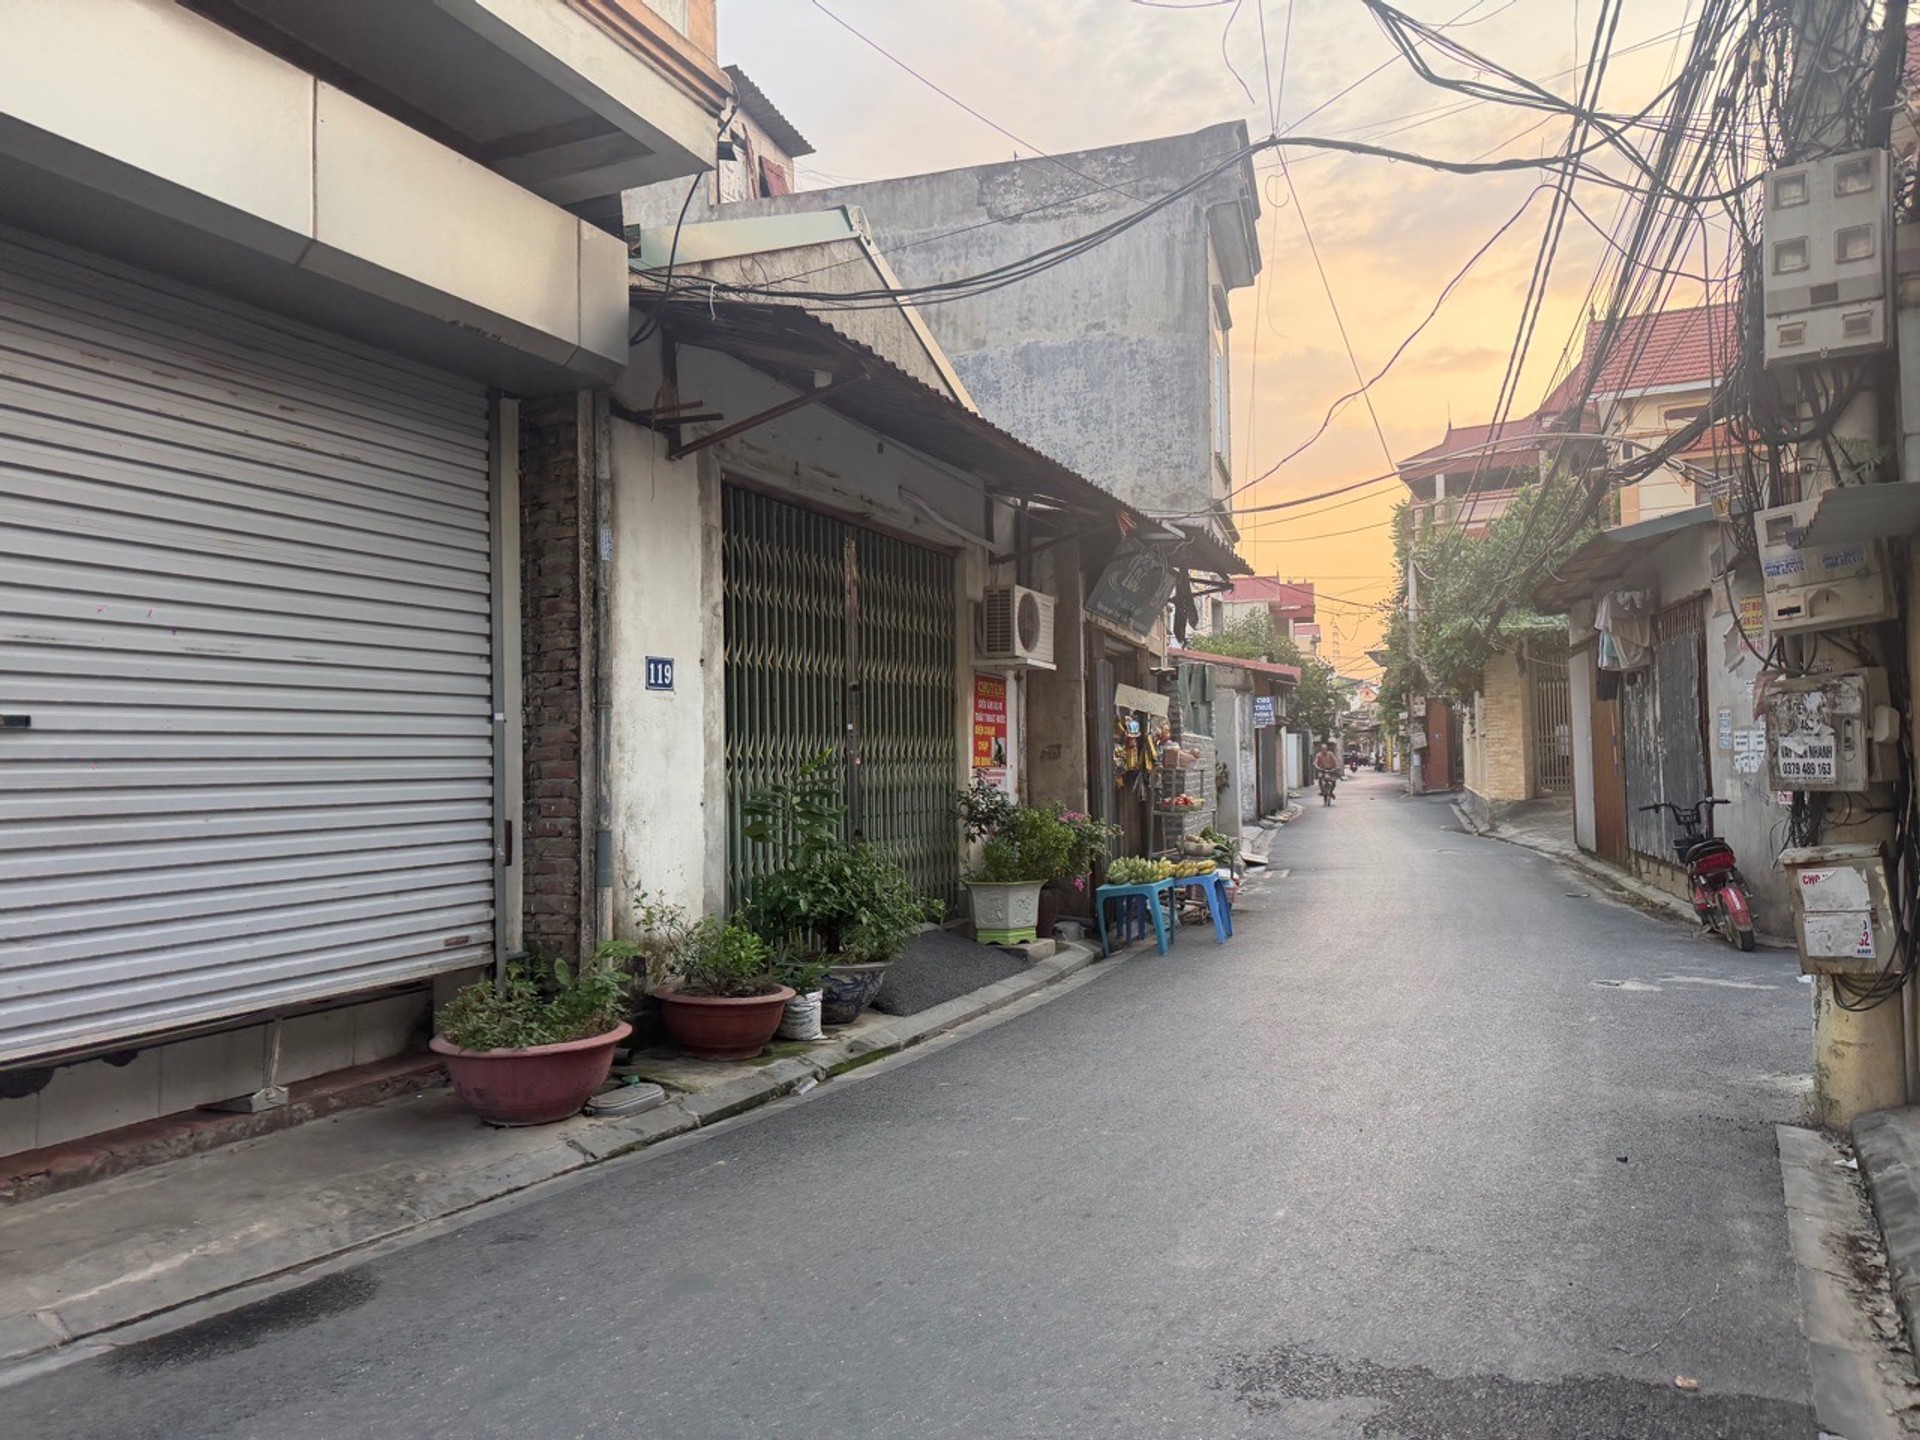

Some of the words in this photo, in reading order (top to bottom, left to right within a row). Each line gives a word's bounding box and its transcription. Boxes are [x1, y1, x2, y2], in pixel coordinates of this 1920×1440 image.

[649, 663, 672, 684] 119
[1808, 746, 1832, 759] NHANH
[1782, 762, 1800, 774] 0379
[1801, 762, 1816, 775] 489
[1818, 763, 1831, 775] 163
